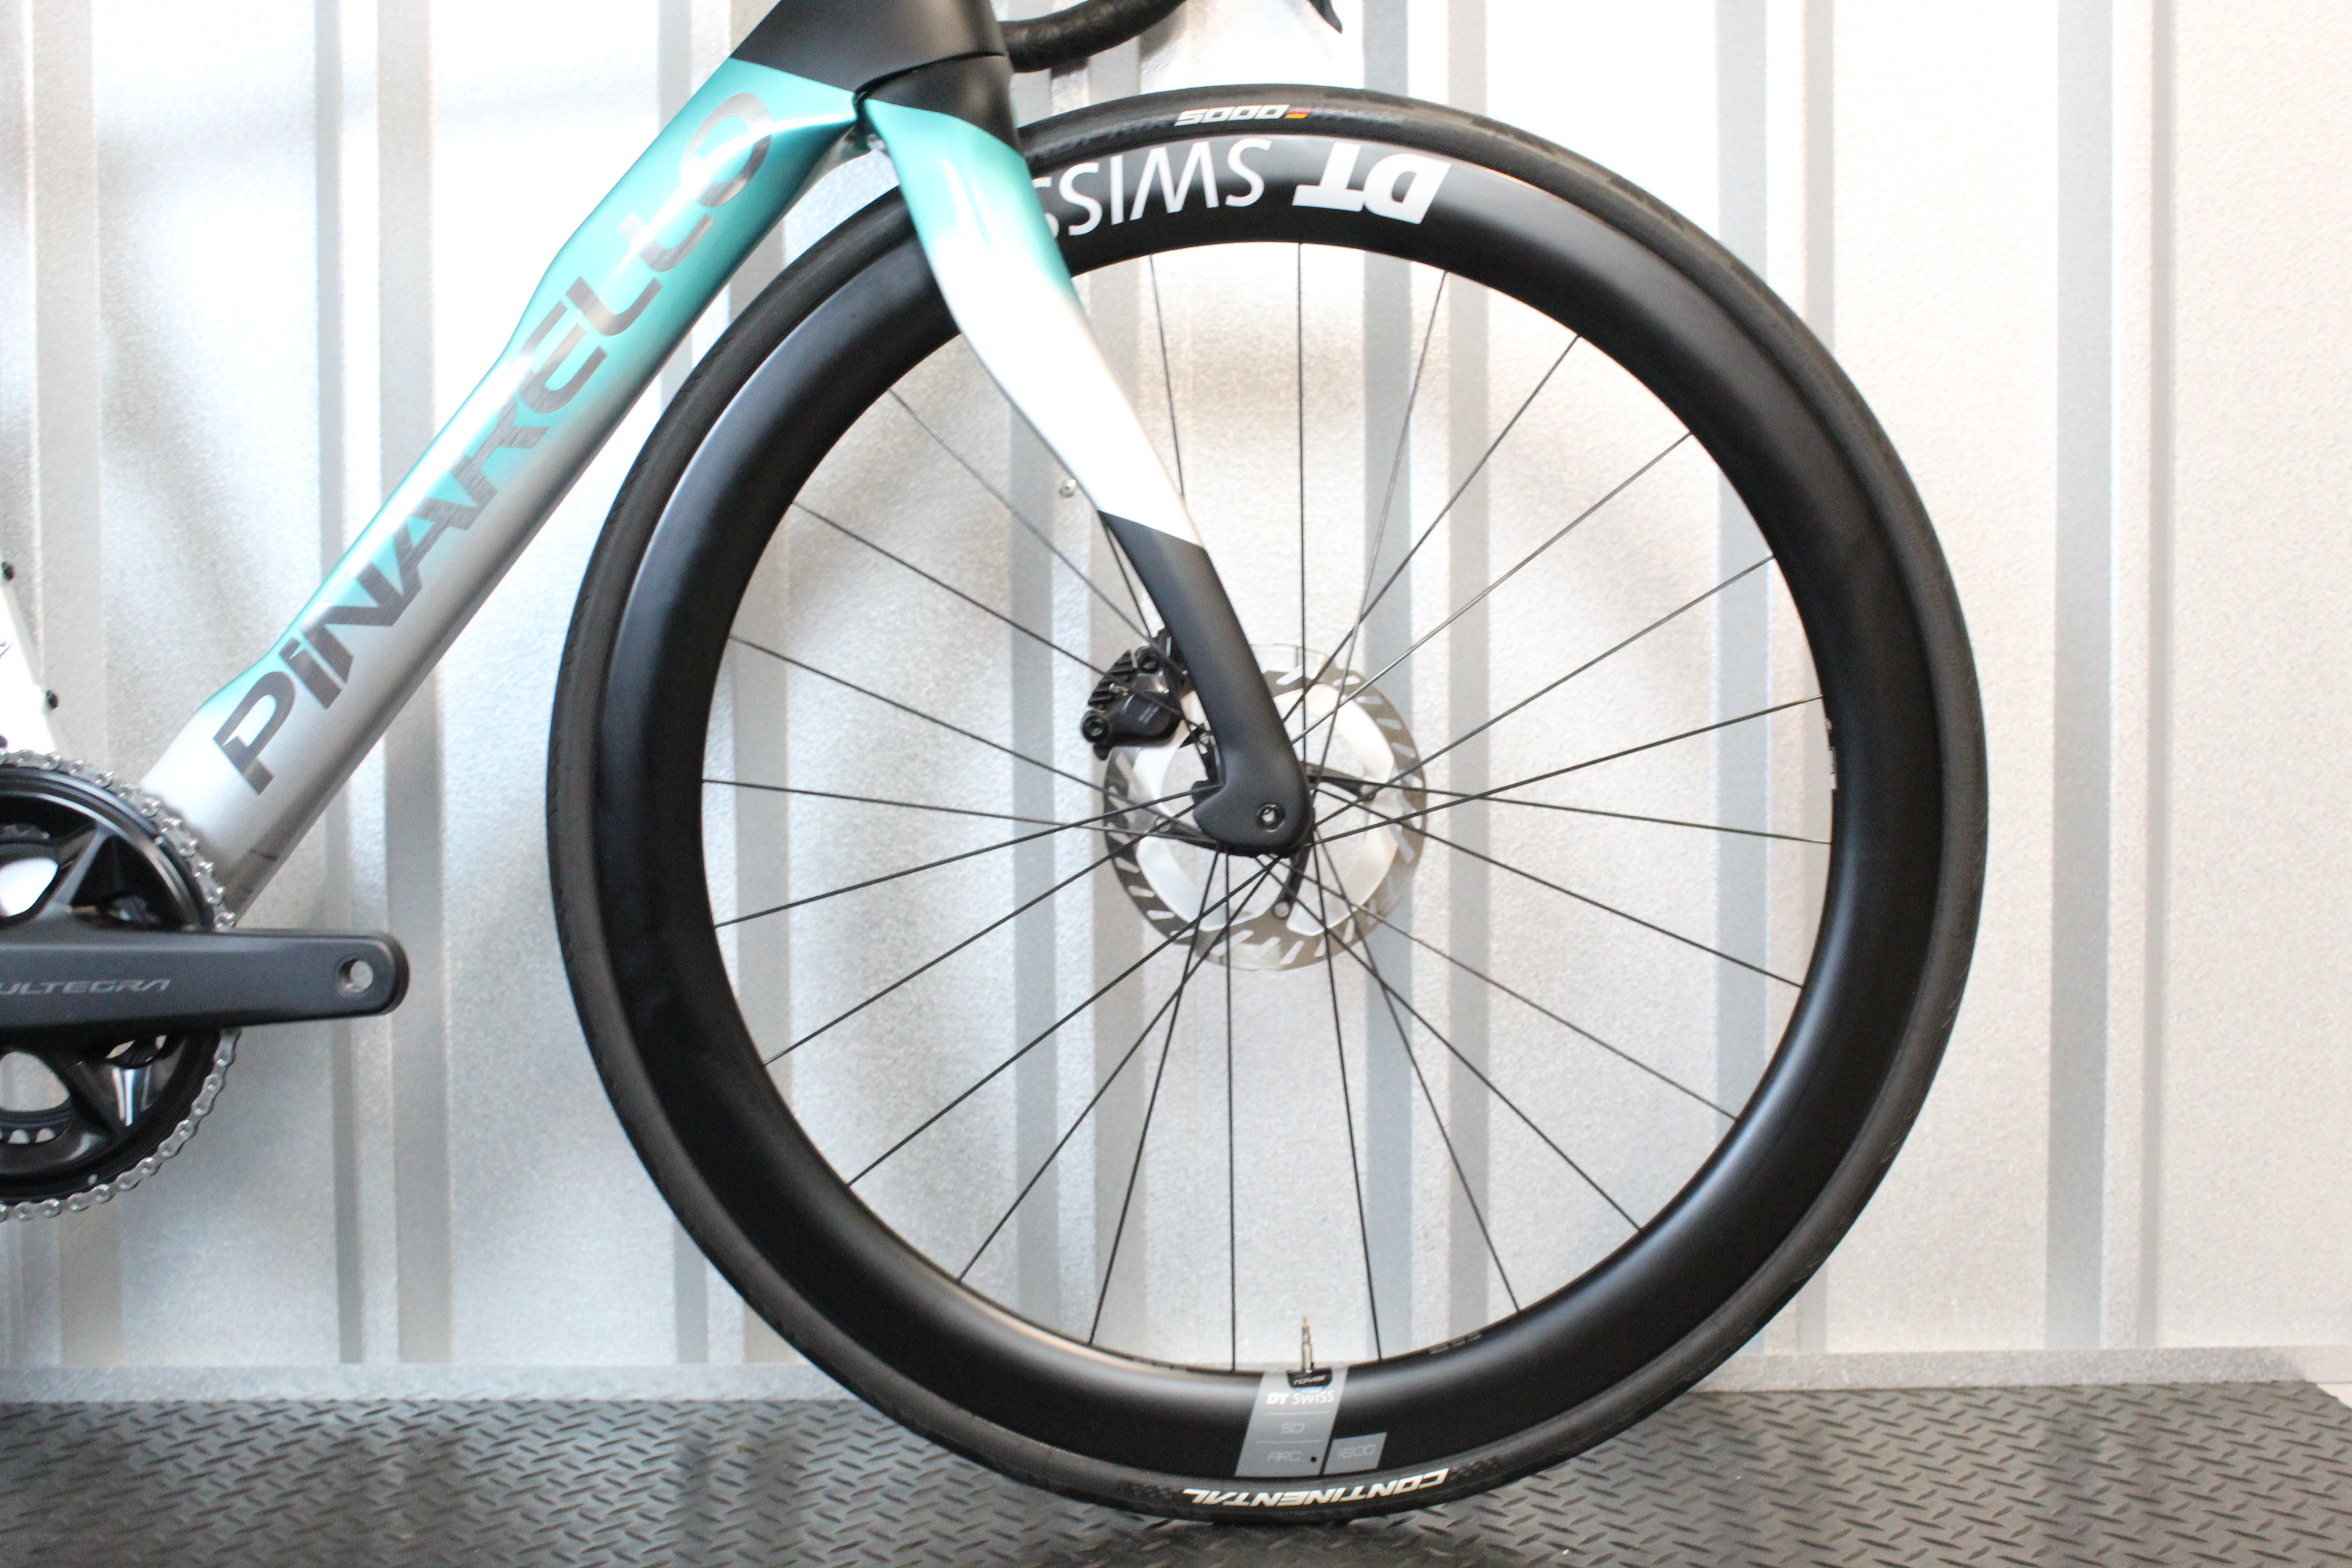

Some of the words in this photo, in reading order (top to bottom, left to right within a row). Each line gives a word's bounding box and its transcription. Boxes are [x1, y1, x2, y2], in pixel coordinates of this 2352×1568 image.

[1174, 104, 1290, 127] 5000
[1292, 142, 1452, 225] DT
[0, 979, 172, 995] ULTEGRA
[1266, 1392, 1290, 1405] DT
[1293, 1390, 1335, 1405] SWISS
[1183, 1468, 1449, 1507] CONTINENTAL
